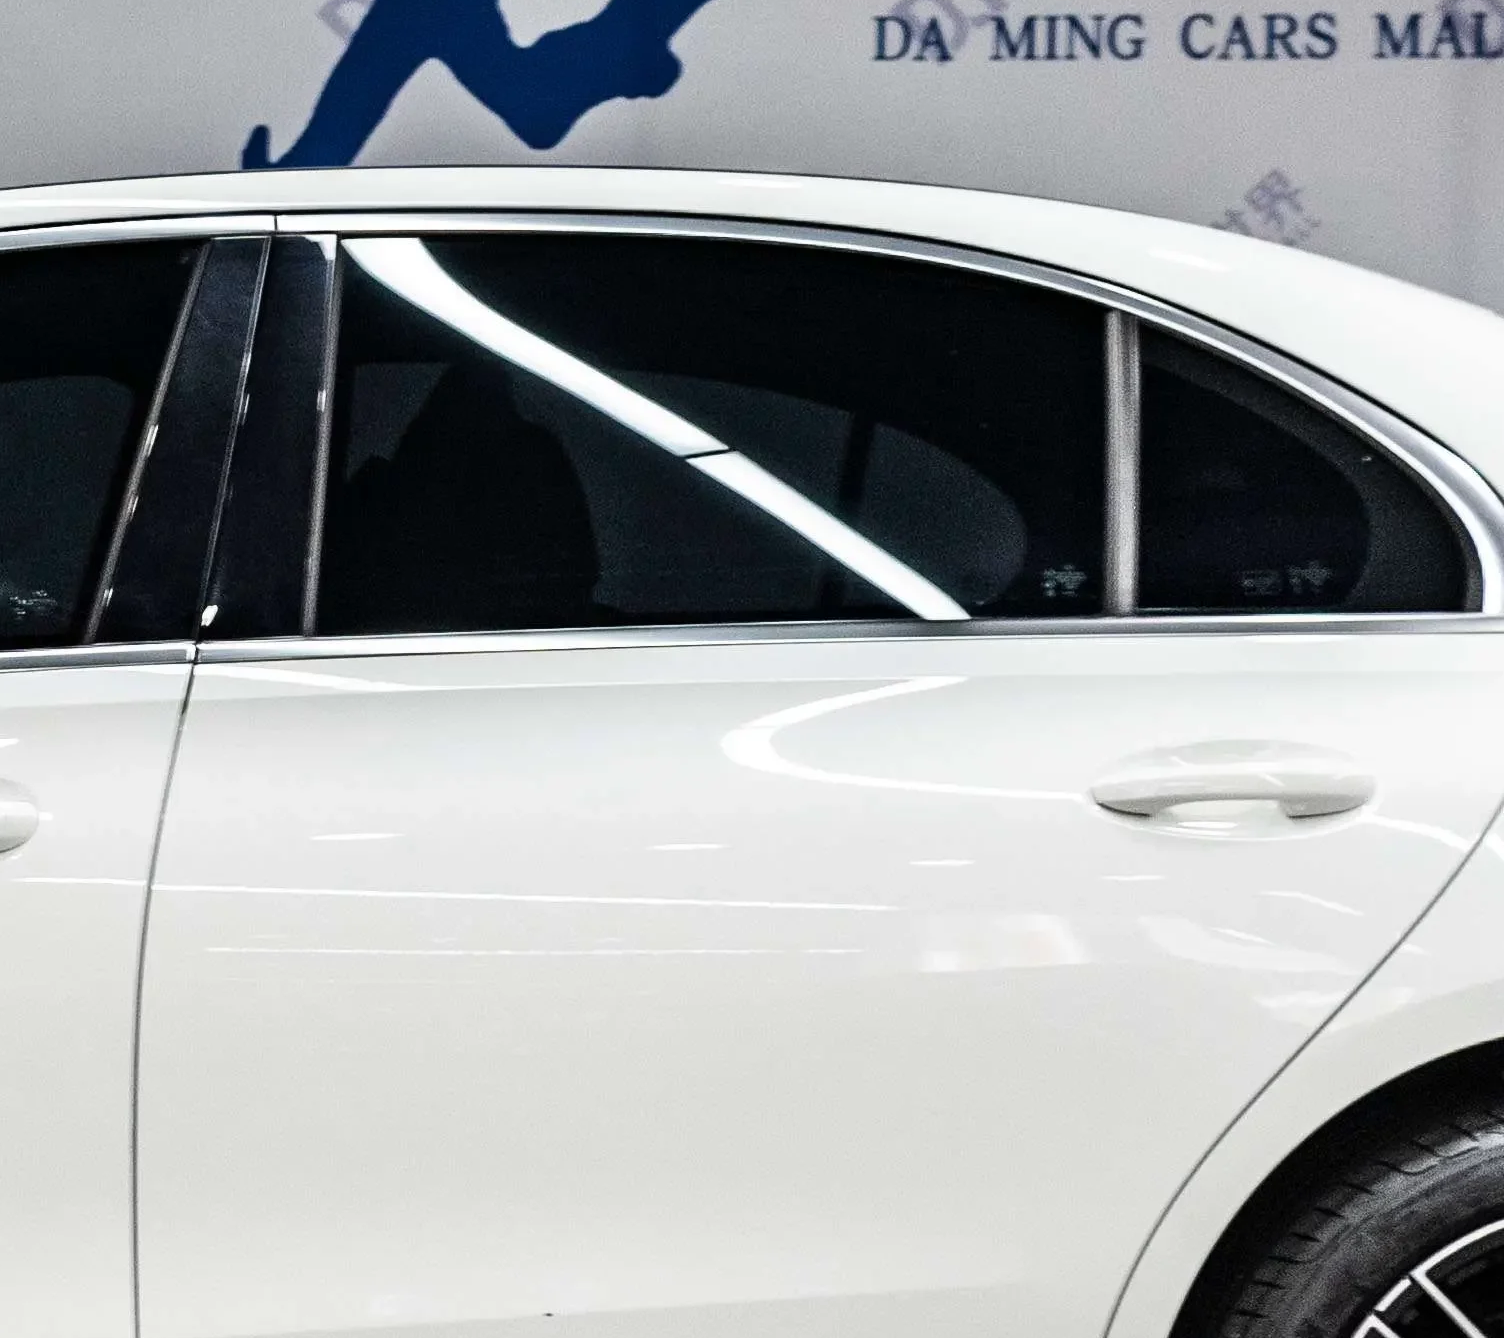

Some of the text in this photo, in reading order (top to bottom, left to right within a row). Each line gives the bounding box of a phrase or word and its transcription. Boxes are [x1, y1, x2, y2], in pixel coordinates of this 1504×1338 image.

[873, 14, 953, 63] DA
[990, 14, 1146, 61] MING
[1180, 12, 1338, 60] CARS
